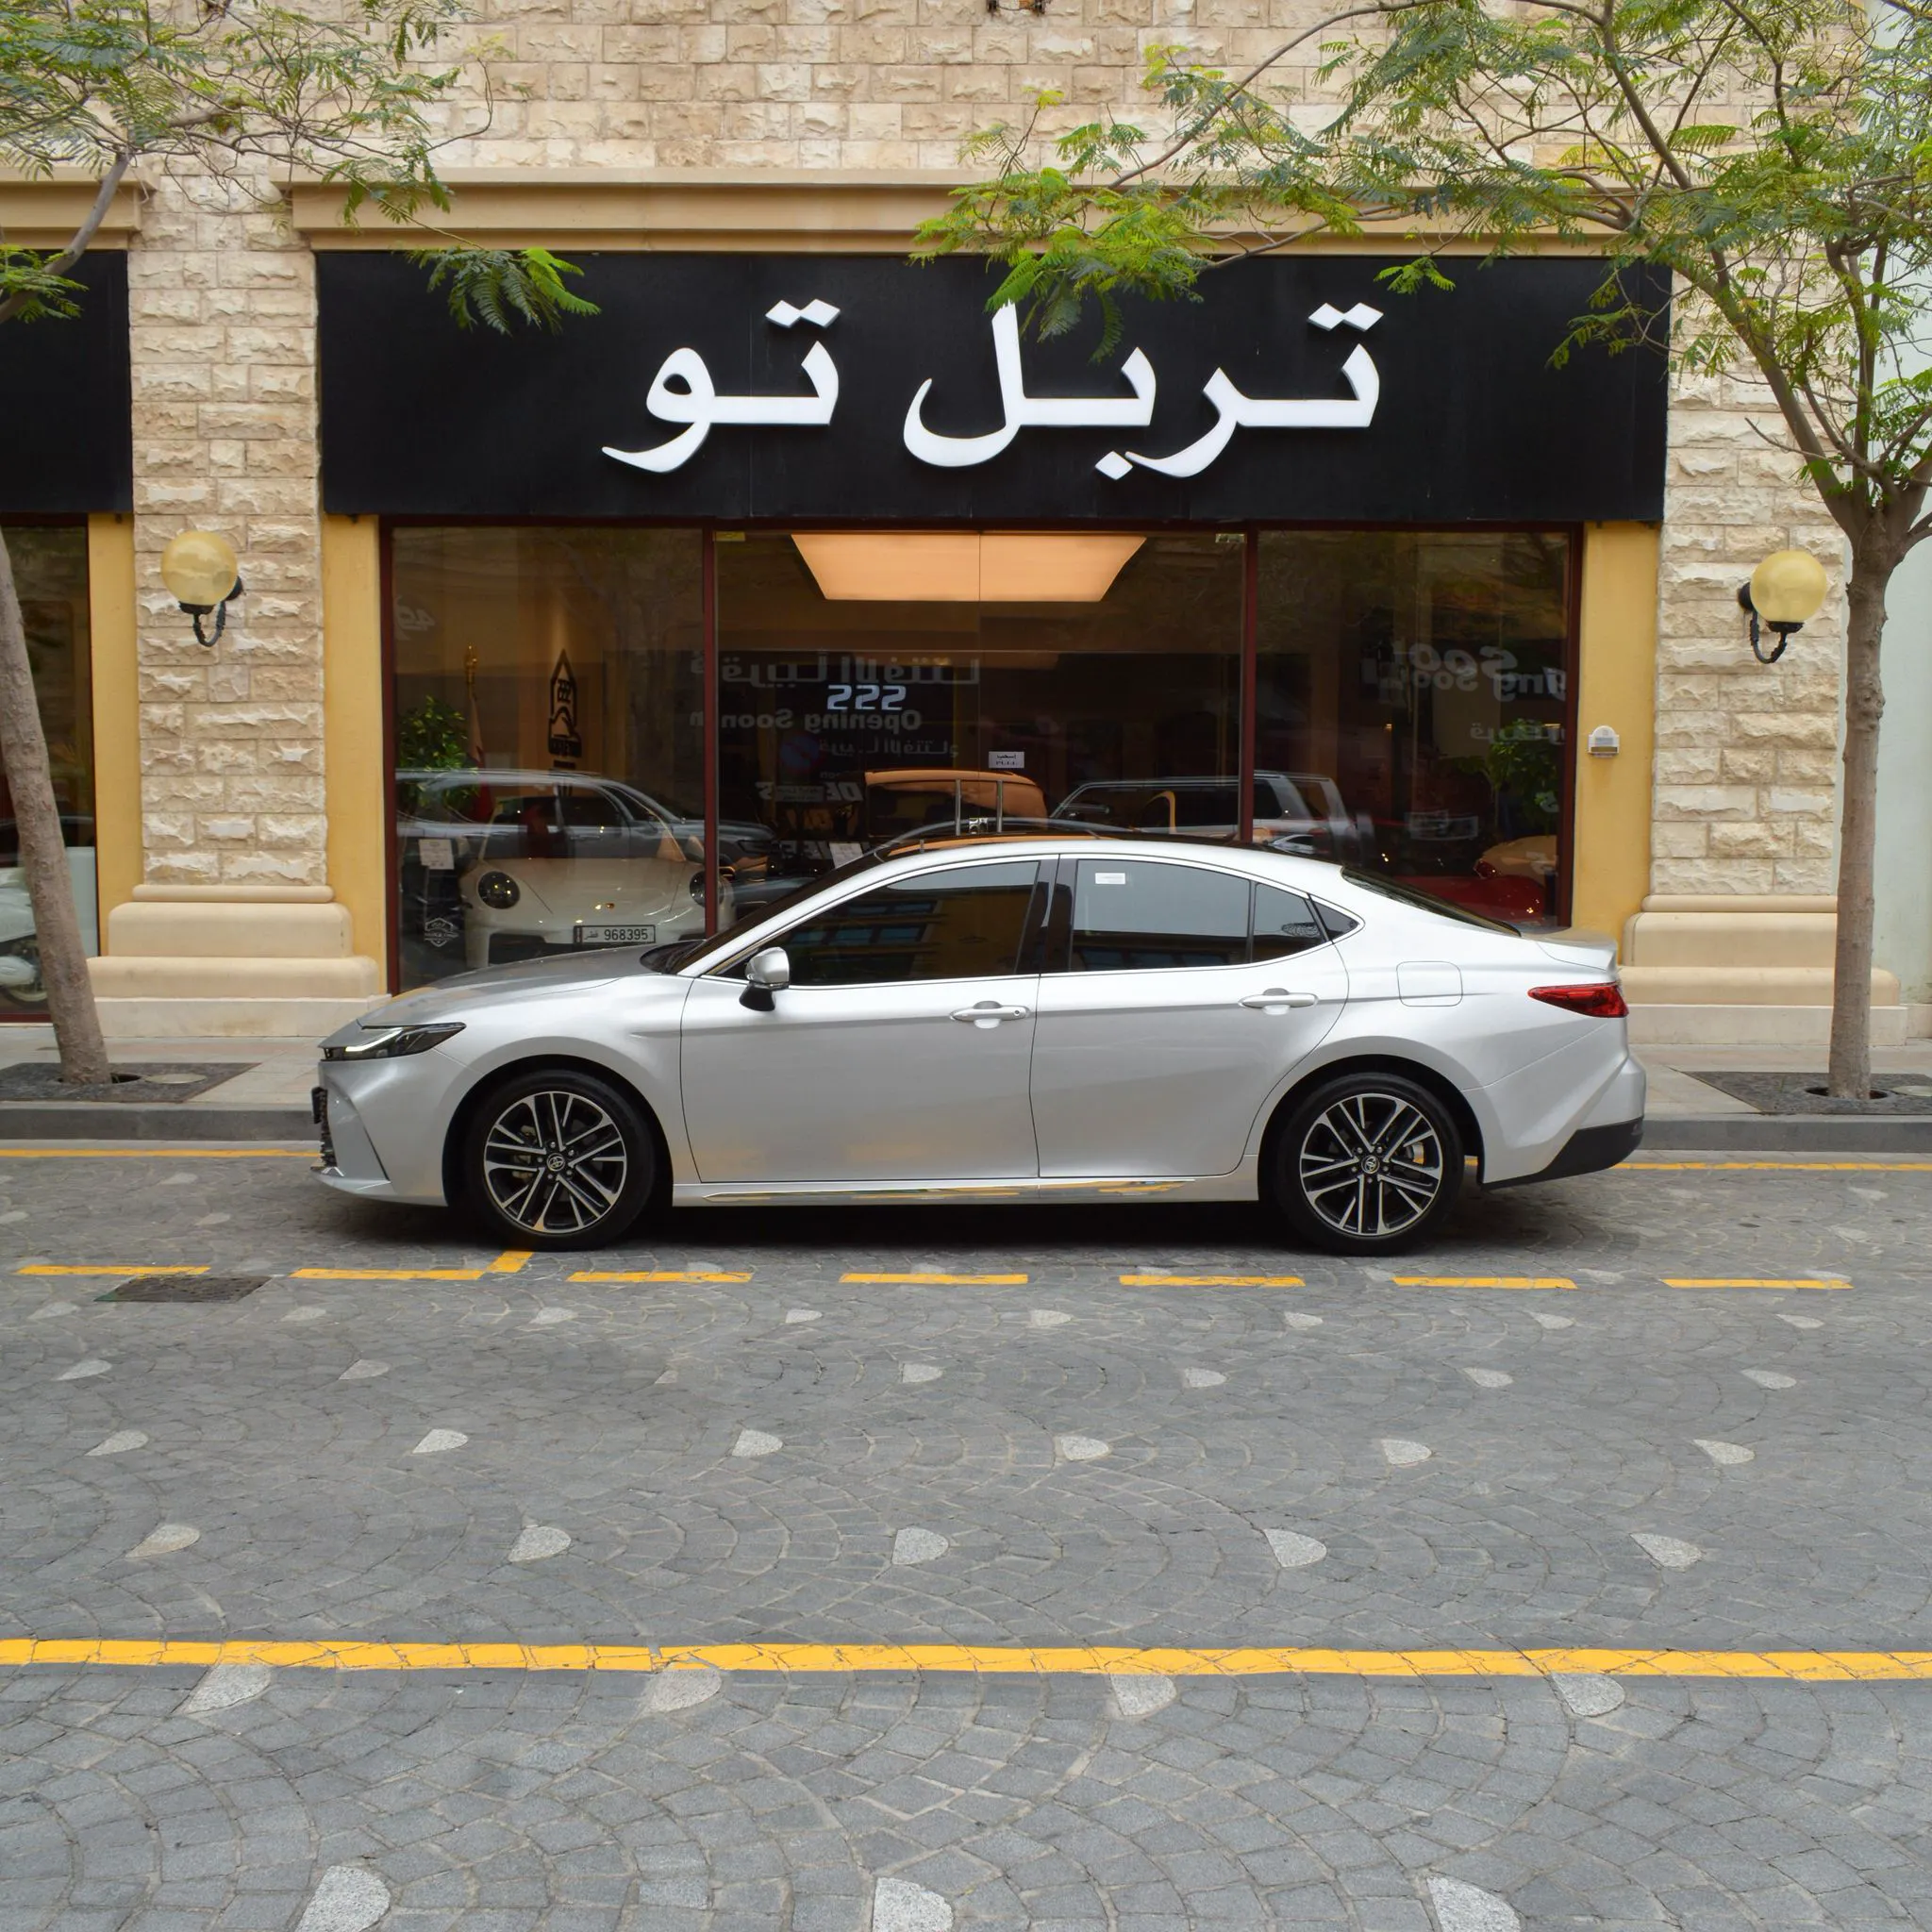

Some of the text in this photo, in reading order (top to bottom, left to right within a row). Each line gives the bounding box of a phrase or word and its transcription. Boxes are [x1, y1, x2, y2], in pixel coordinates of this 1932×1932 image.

[601, 298, 1385, 481] تربل تو
[826, 684, 907, 710] 222
[604, 928, 648, 941] 968395
